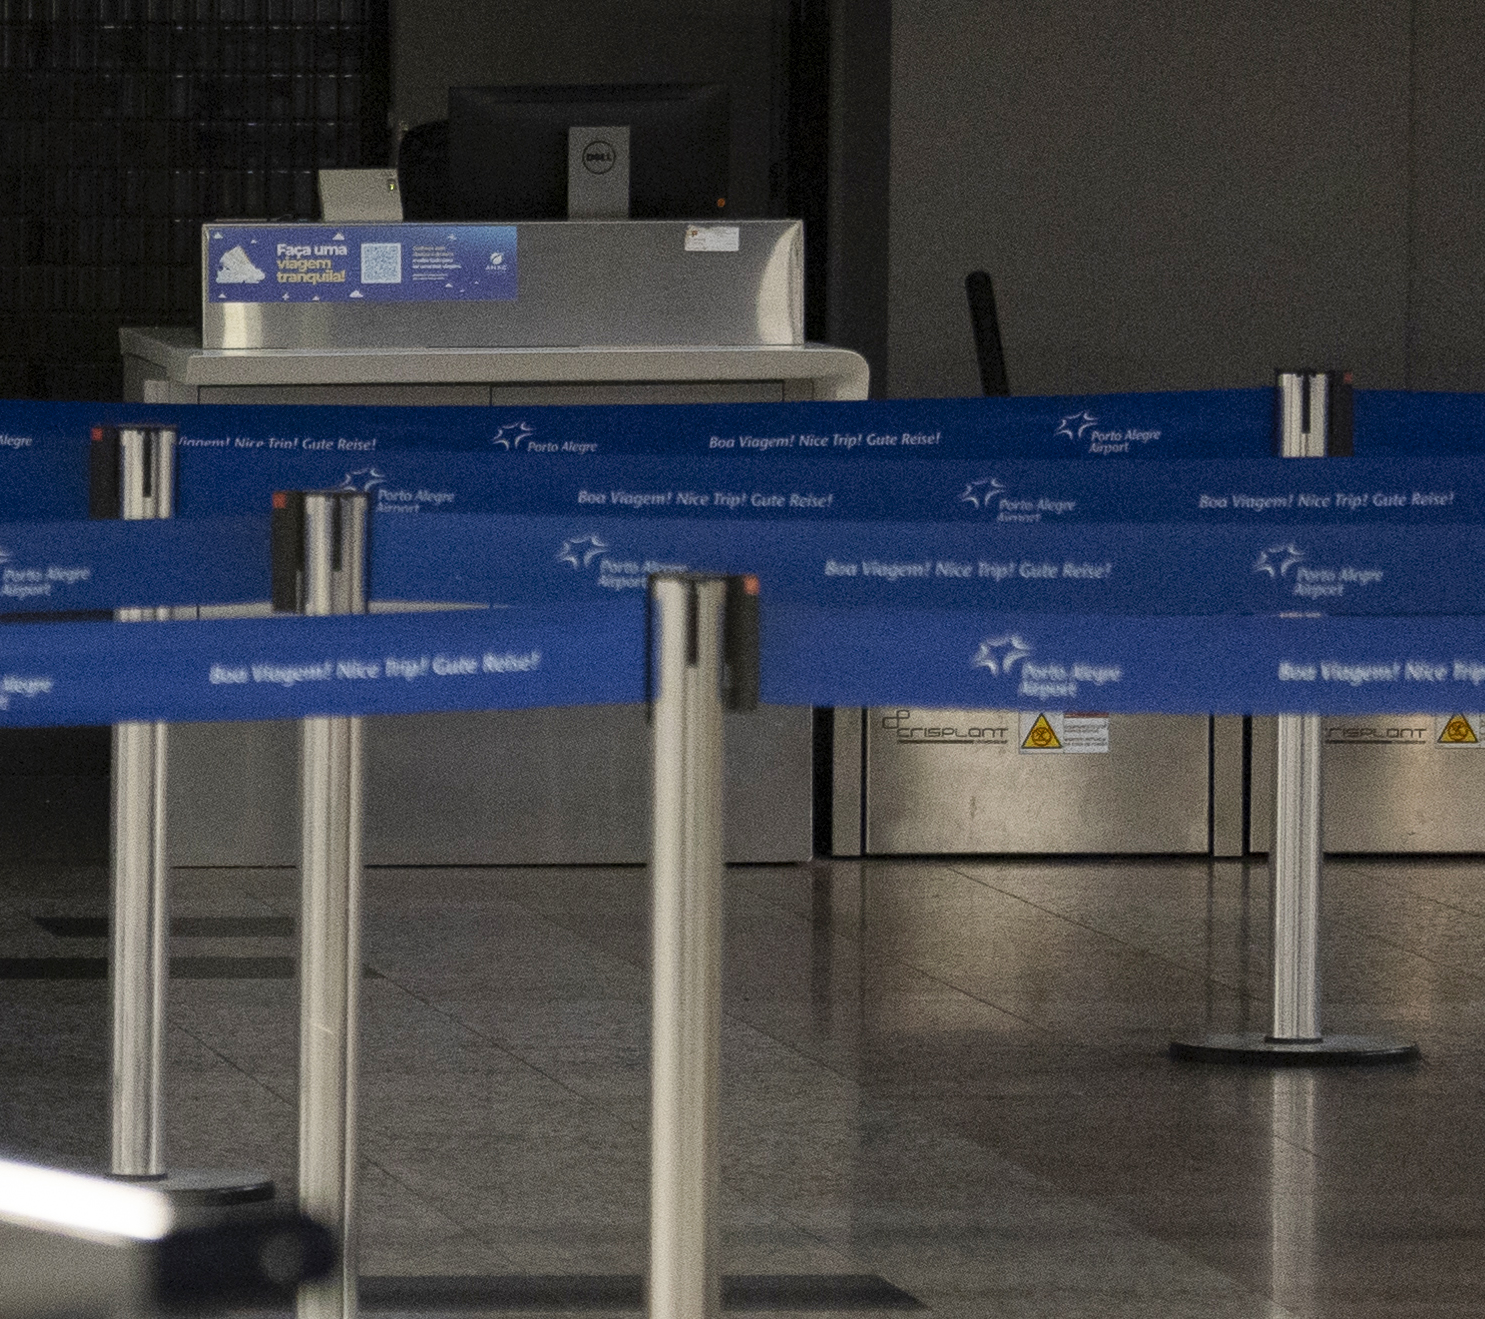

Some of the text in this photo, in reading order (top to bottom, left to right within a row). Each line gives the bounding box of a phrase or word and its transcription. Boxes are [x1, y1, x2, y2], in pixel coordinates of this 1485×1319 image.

[277, 244, 347, 258] Faça uma
[277, 258, 331, 271] viagem
[277, 270, 345, 285] tranquila!
[302, 437, 334, 450] Gute
[337, 438, 377, 451] Reise!
[708, 431, 942, 451] Boa Viagem! Nice Trip! Gute Reise!
[1091, 429, 1161, 444] Porto Alegre
[527, 441, 598, 455] Porto Alegre
[577, 488, 833, 509] Boa Viagem! Nice Trip! Gute Reise!
[1198, 491, 1455, 512] Boa Viagem! Nice Trip! Gute Reise!
